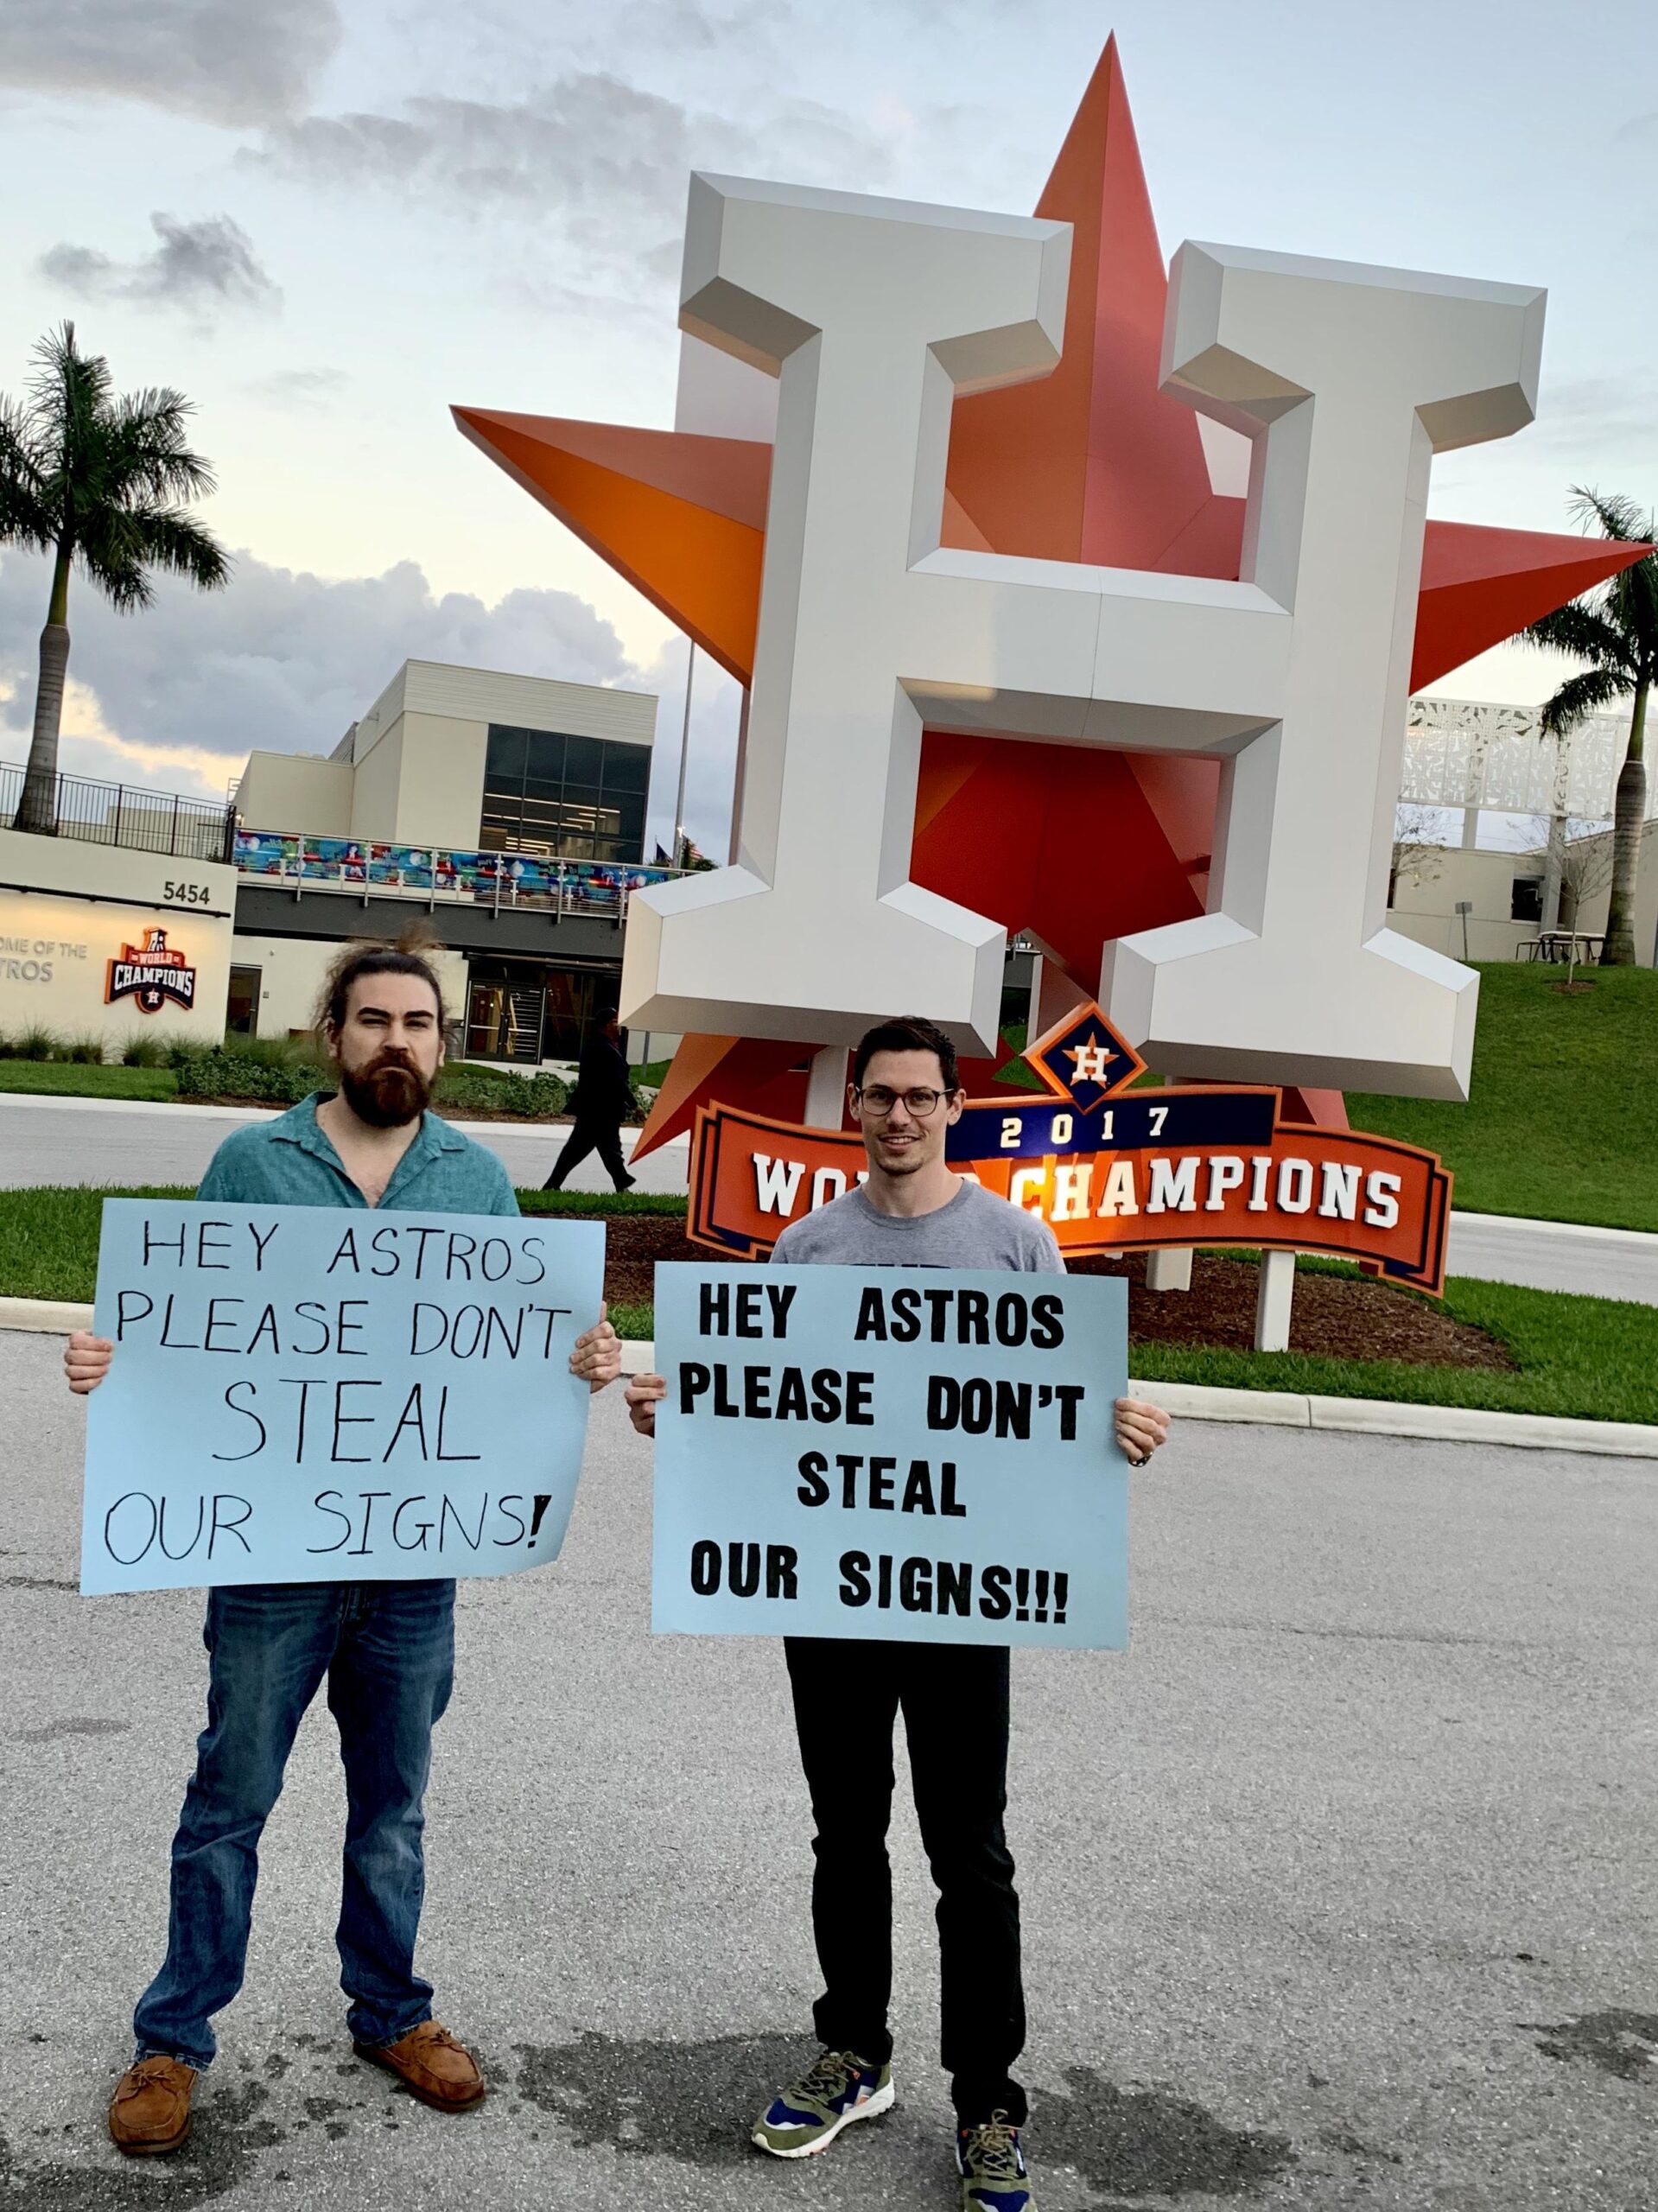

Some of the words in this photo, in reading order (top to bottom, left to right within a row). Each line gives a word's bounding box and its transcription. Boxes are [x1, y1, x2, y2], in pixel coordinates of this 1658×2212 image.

[163, 880, 210, 905] 5454
[33, 939, 55, 955] OF
[59, 942, 87, 958] THE
[114, 963, 194, 997] CHAMPIONS
[139, 951, 173, 965] WORLD
[1071, 1045, 1111, 1082] H
[1000, 1107, 1169, 1148] 2017
[1009, 1156, 1401, 1229] CHAMPIONS
[143, 1220, 278, 1271] HEY
[327, 1227, 545, 1285] ASTROS
[118, 1290, 369, 1356] PLEASE
[410, 1302, 572, 1359] DON'T
[699, 1282, 797, 1338] HEY
[854, 1287, 1064, 1349] ASTROS
[212, 1379, 481, 1464] STEAL
[679, 1362, 874, 1426] PLEASE
[927, 1376, 1085, 1440] DON'T
[797, 1451, 967, 1517] STEAL
[105, 1492, 252, 1565] OUR
[306, 1491, 552, 1555] SIGNS!
[690, 1540, 798, 1600] OUR
[838, 1550, 1070, 1624] SIGNS!!!
